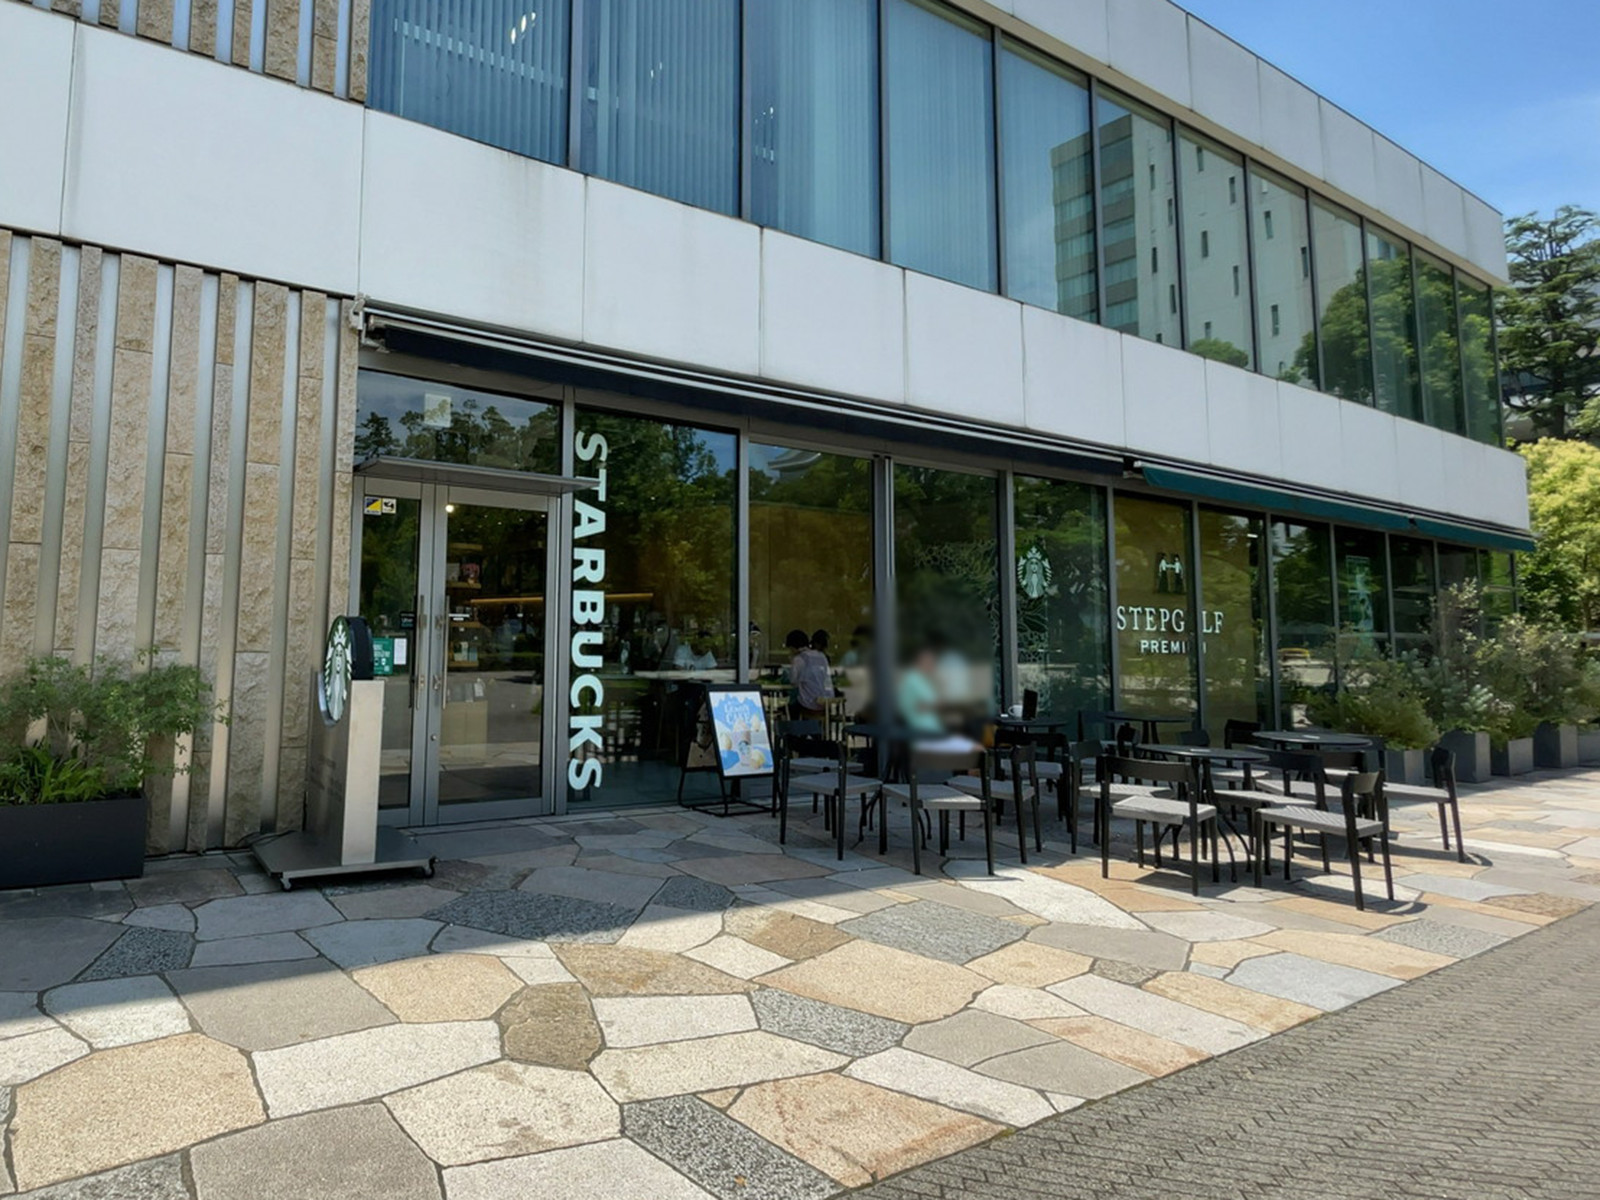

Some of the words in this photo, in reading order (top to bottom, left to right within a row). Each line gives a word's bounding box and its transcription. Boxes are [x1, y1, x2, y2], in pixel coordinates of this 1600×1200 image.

[569, 431, 608, 792] STARBUCKS
[1116, 605, 1224, 634] STEPGLF
[1140, 639, 1207, 654] PREMI
